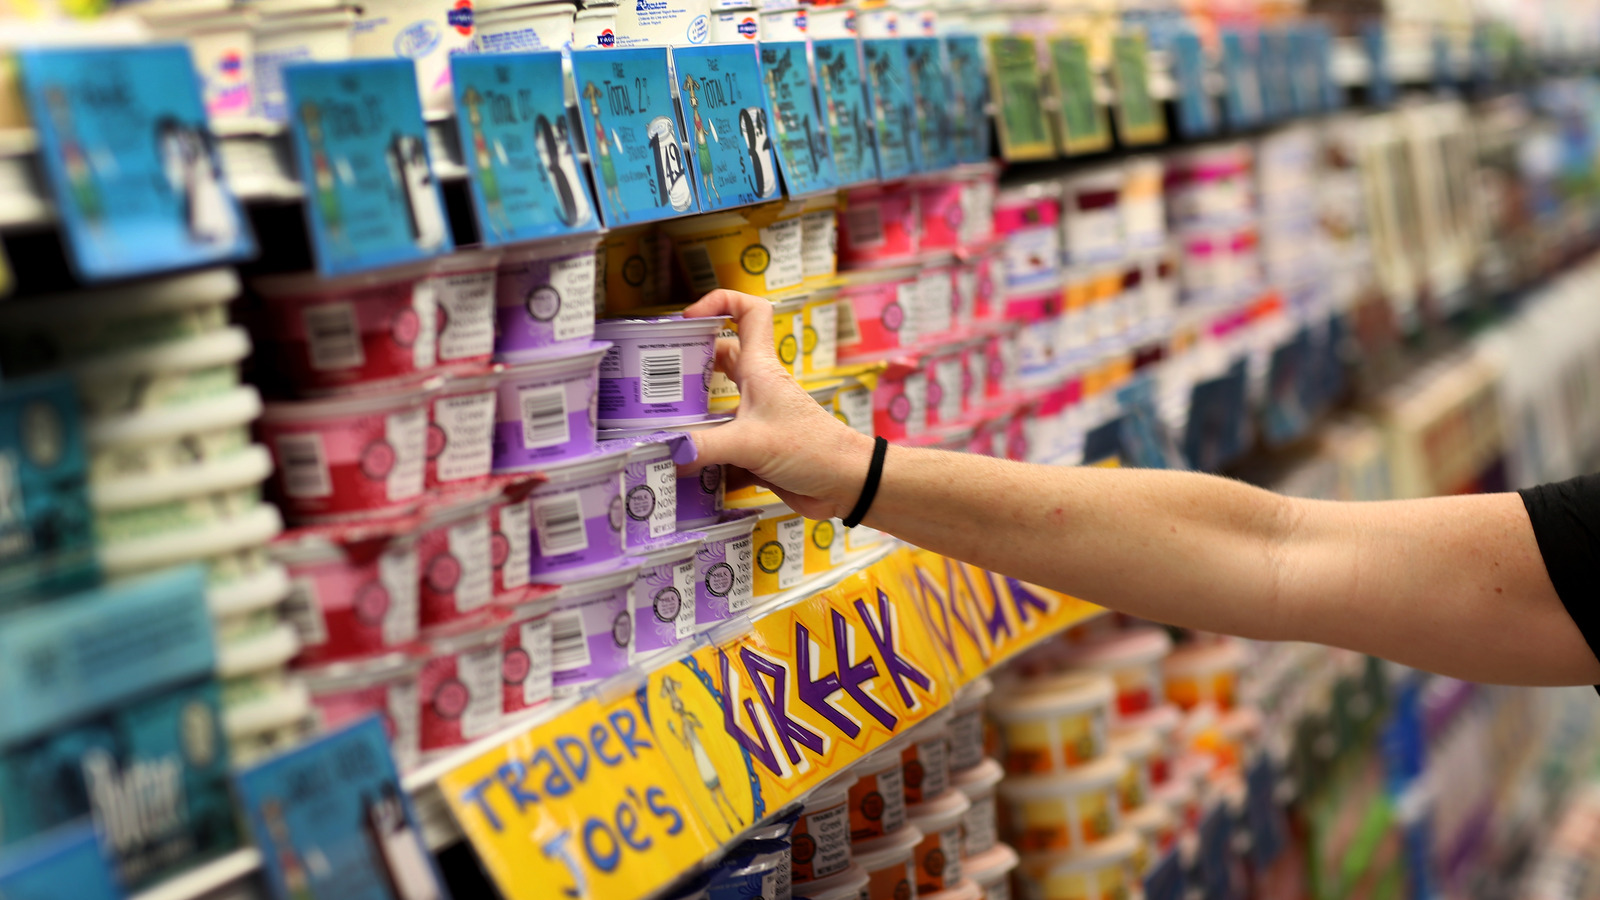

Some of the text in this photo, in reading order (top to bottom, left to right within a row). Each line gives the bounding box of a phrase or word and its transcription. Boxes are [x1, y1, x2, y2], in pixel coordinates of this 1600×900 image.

[603, 79, 635, 117] TOTAL
[700, 77, 728, 109] TOTAL
[660, 472, 676, 484] Gree
[718, 587, 932, 778] GREEK
